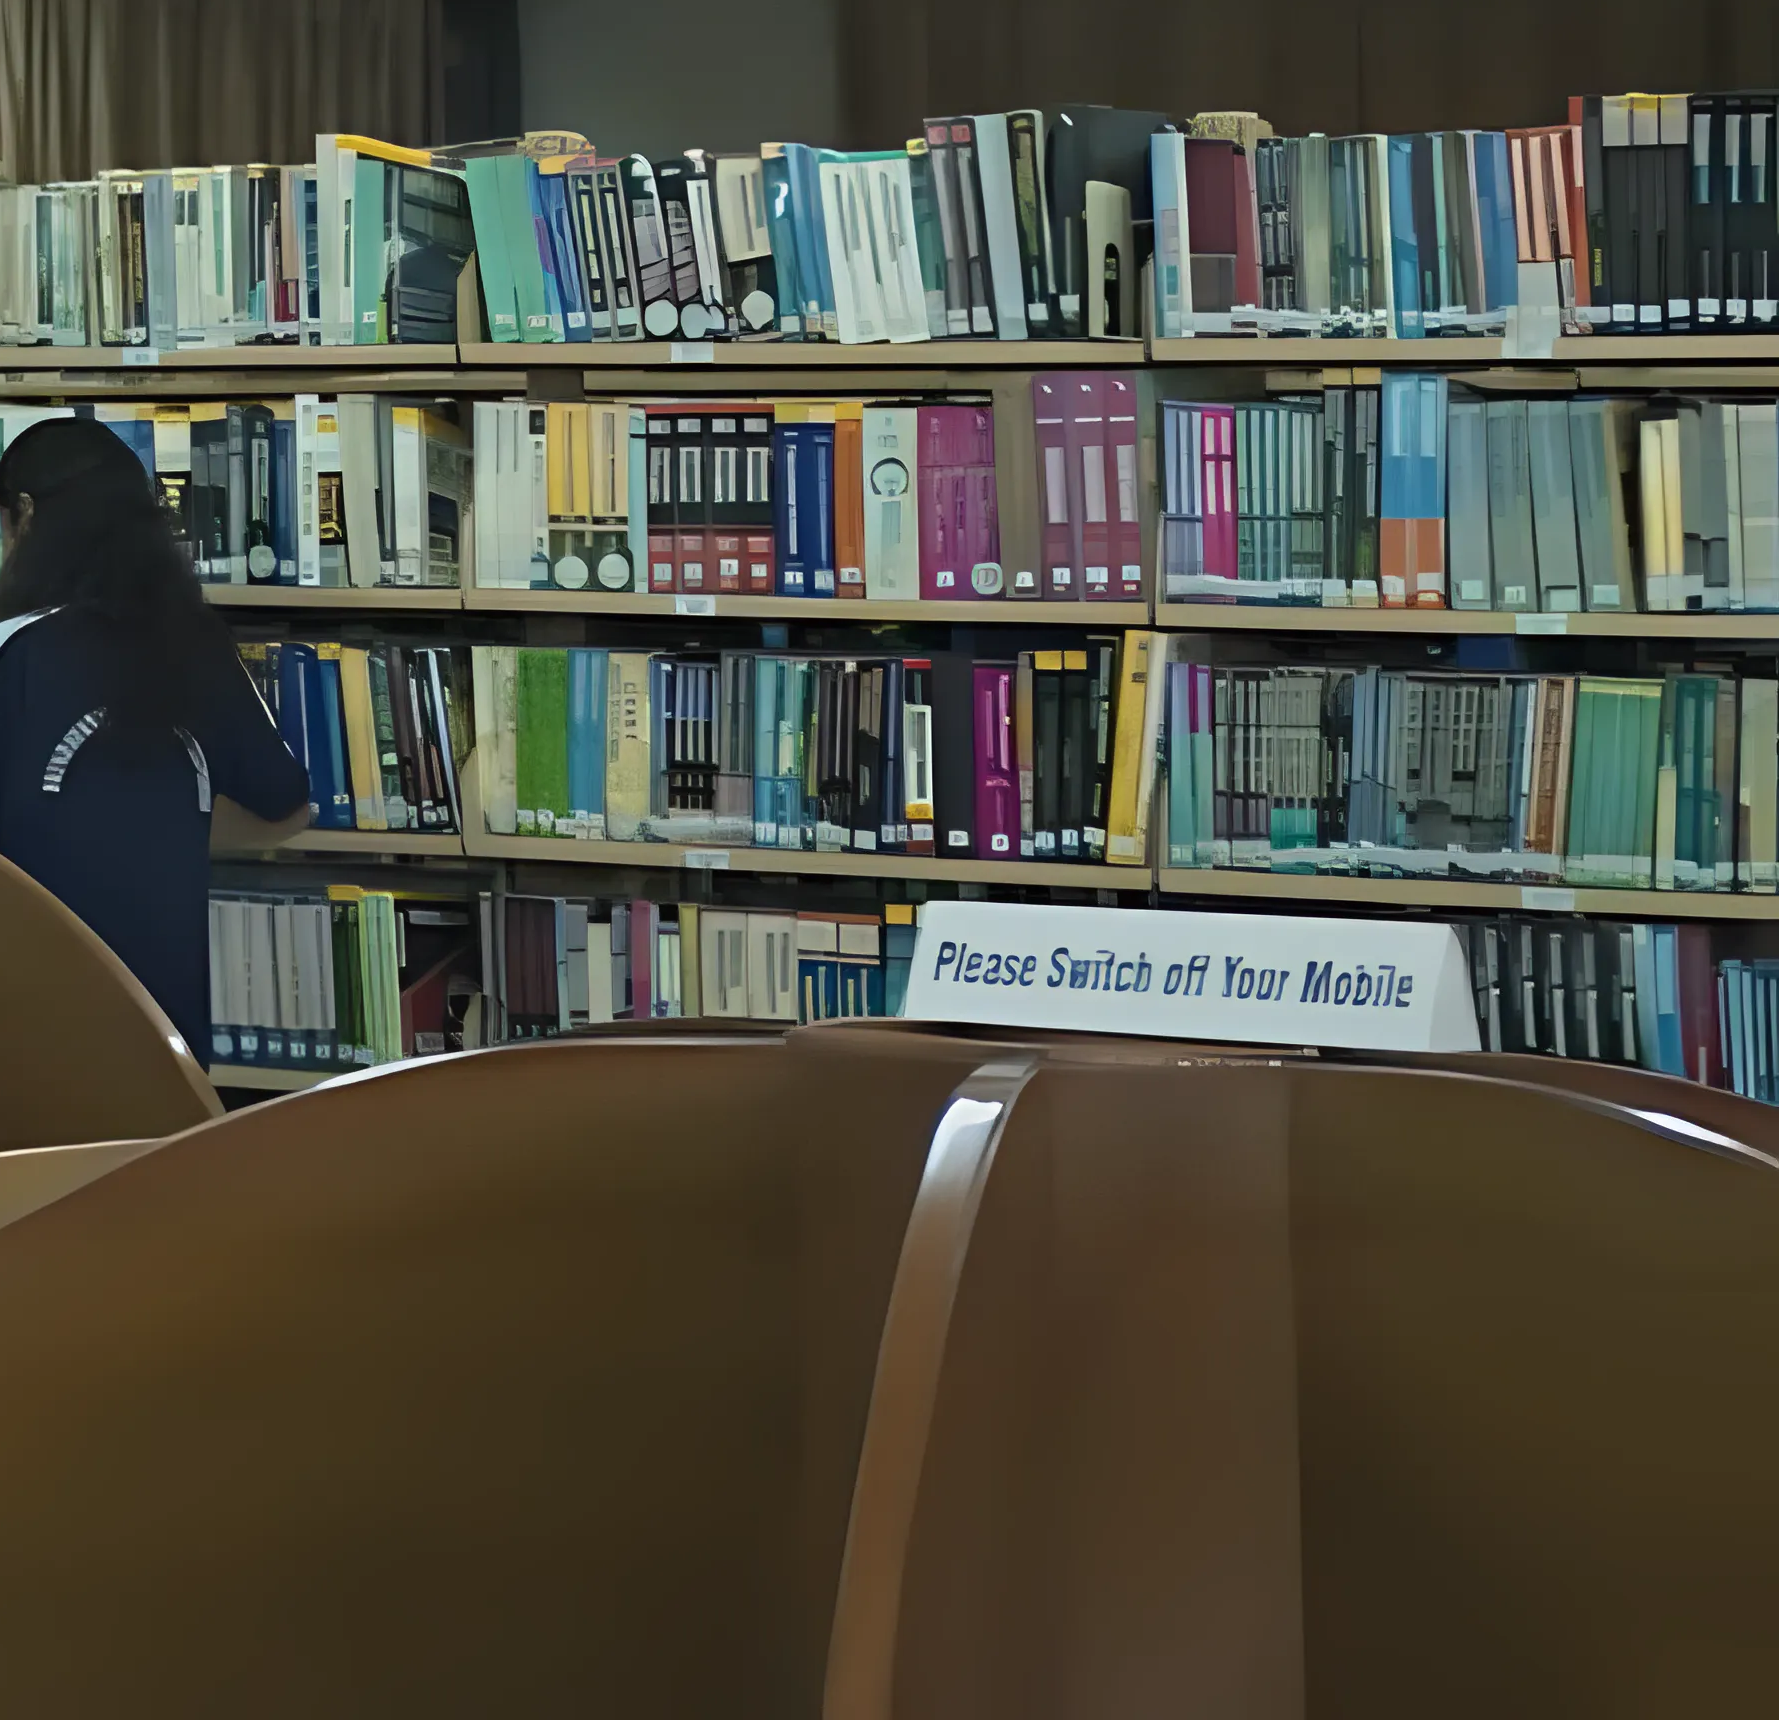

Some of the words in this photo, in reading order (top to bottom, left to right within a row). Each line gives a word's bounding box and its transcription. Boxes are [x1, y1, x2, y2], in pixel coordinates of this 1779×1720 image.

[933, 940, 1037, 987] Please
[1046, 946, 1153, 993] Switch
[1221, 955, 1291, 1002] Your
[1299, 960, 1414, 1008] Mobile
